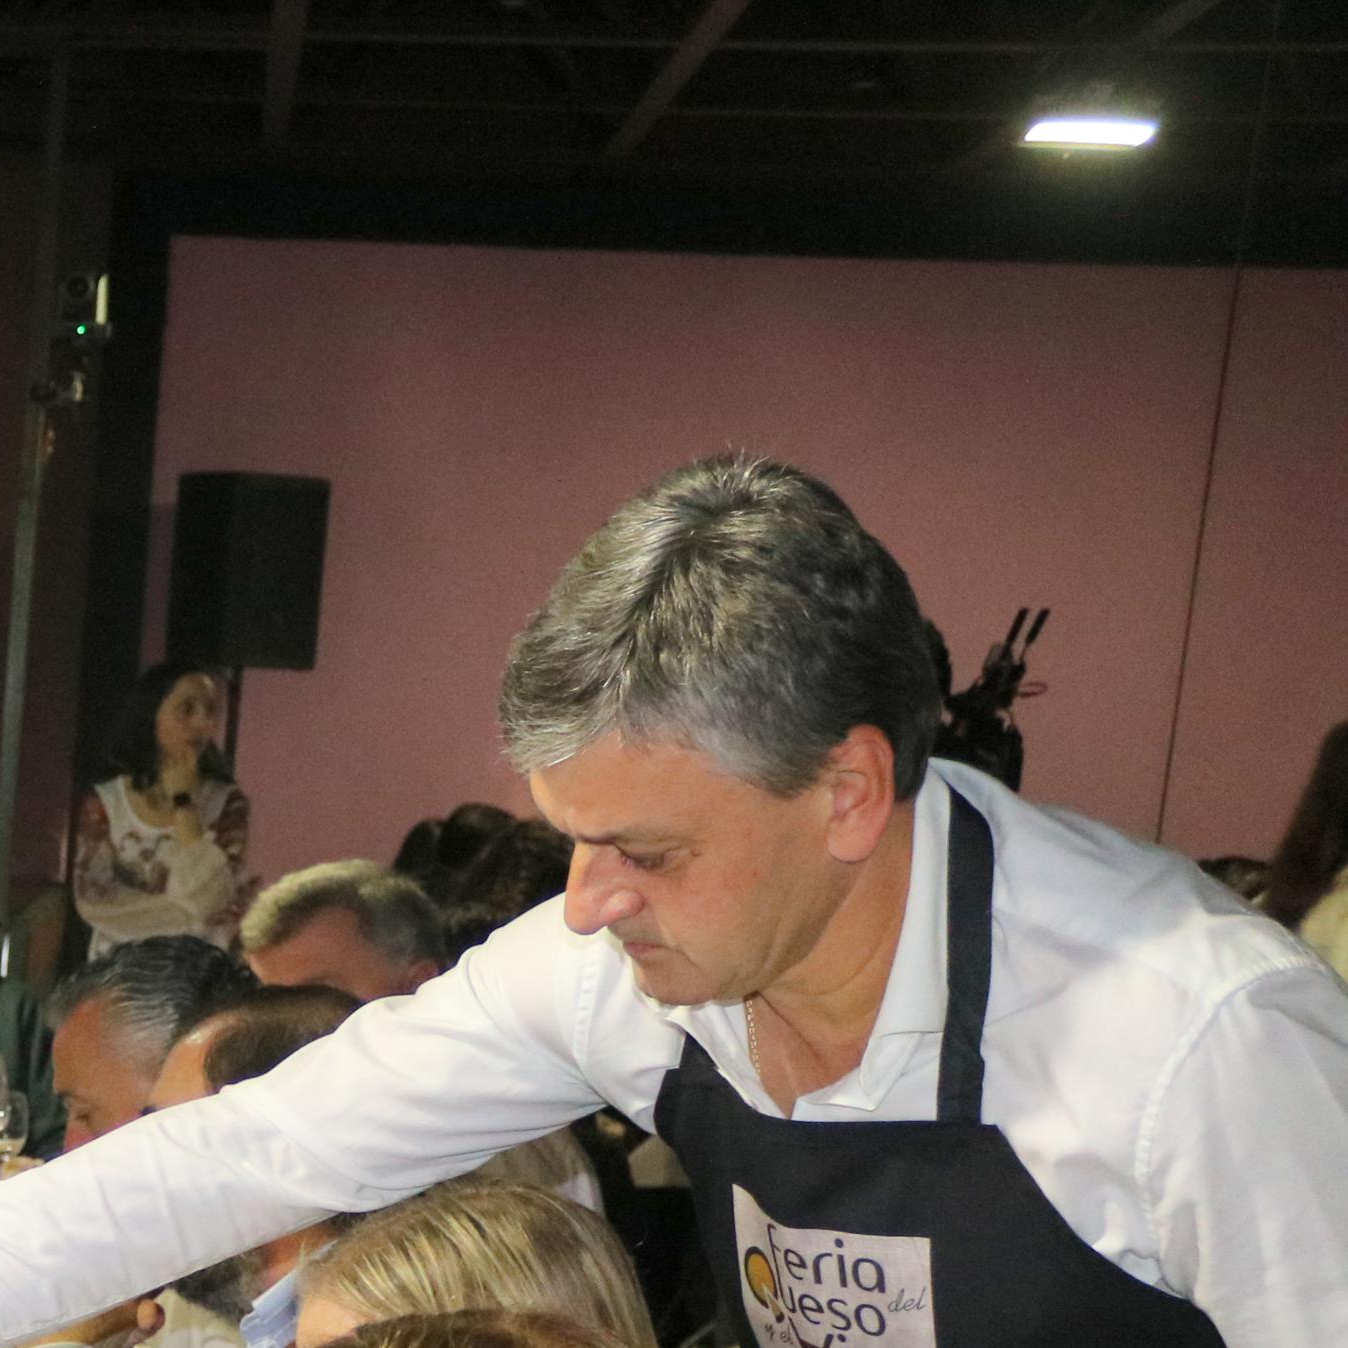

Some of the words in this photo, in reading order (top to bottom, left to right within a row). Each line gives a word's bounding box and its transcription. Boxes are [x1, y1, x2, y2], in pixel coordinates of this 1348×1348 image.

[744, 1246, 886, 1337] Queso
[888, 1287, 926, 1313] del
[767, 1223, 886, 1294] Feria
